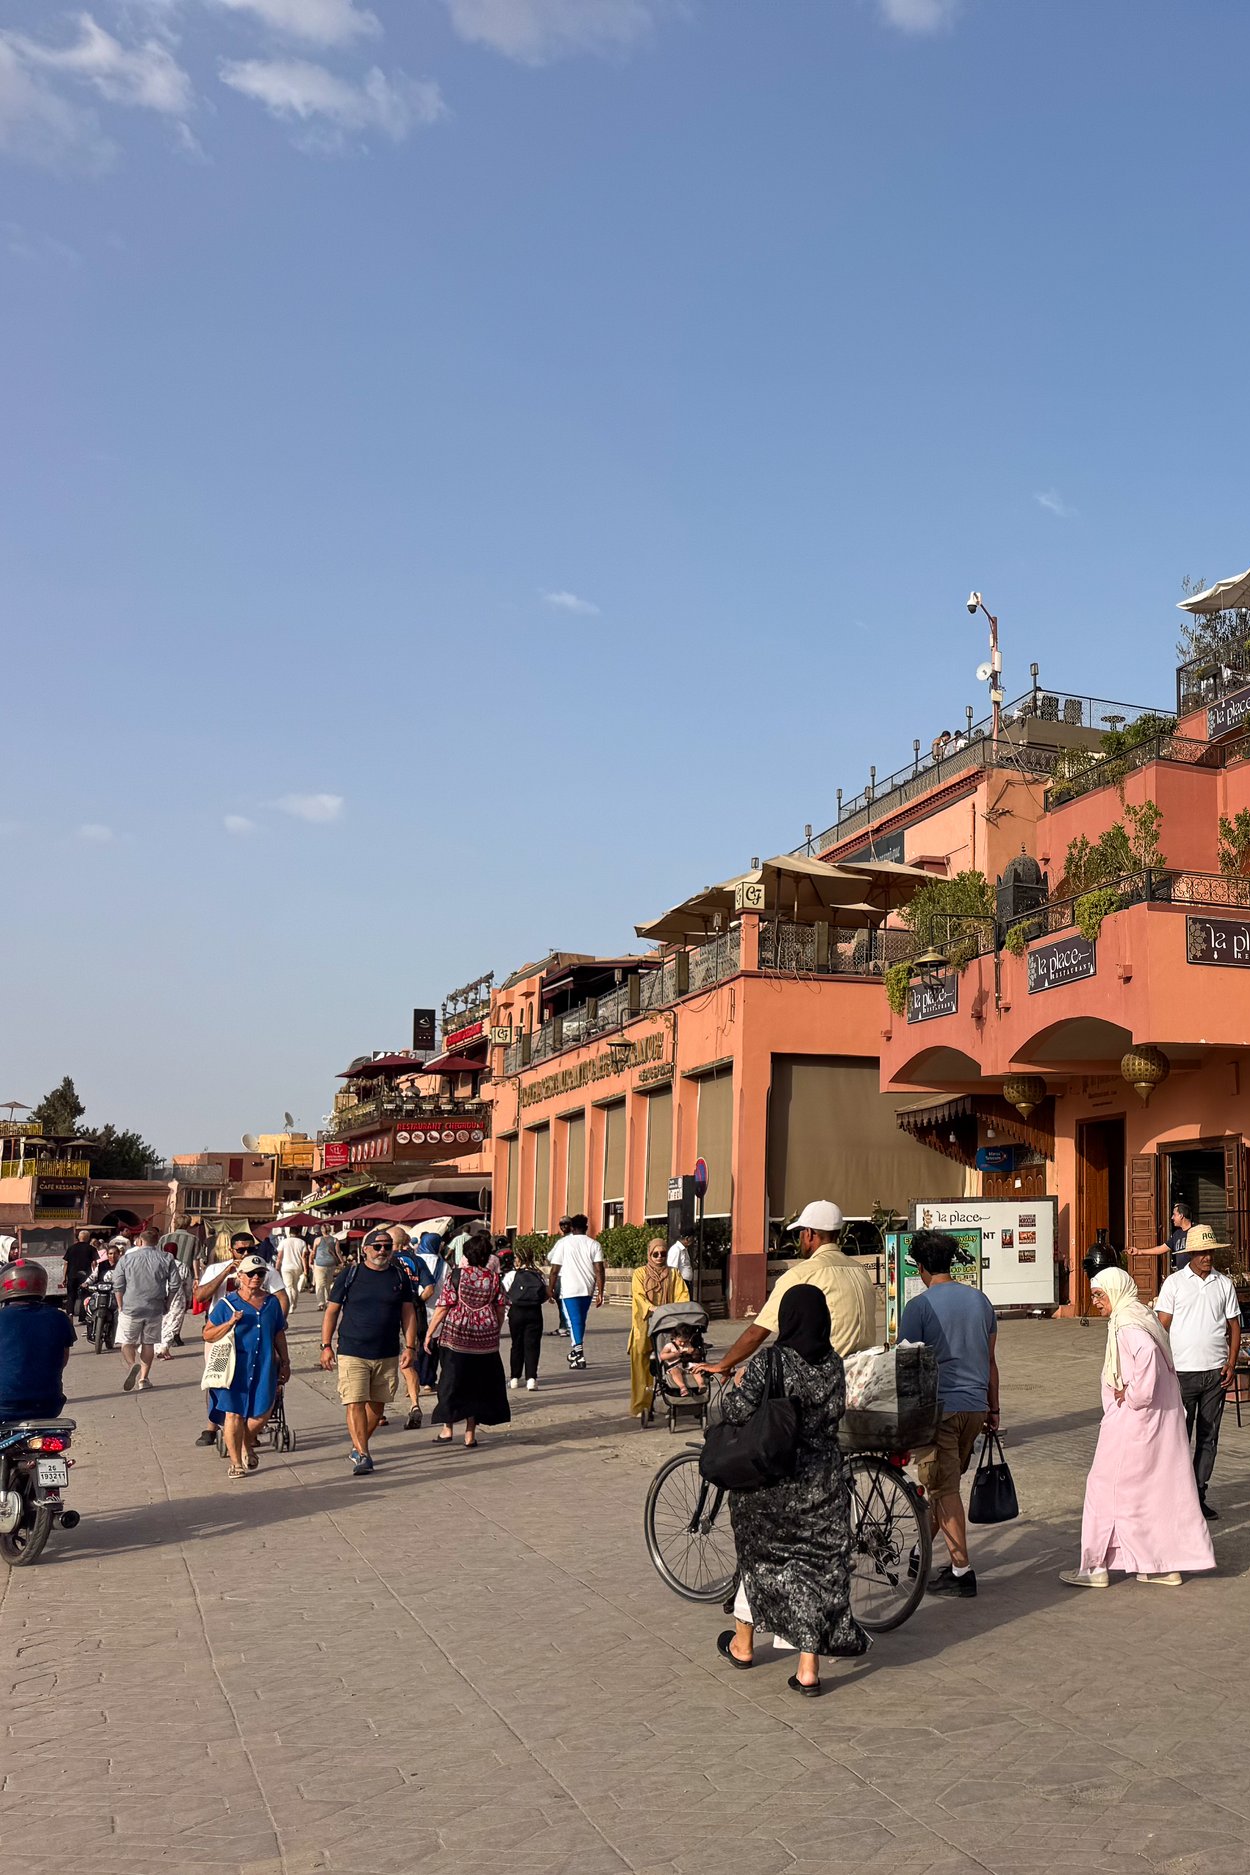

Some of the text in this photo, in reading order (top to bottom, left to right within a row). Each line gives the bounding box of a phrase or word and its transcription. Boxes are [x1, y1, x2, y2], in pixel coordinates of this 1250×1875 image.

[1205, 923, 1227, 949] la
[1035, 947, 1092, 980] la place
[936, 1209, 991, 1225] la place
